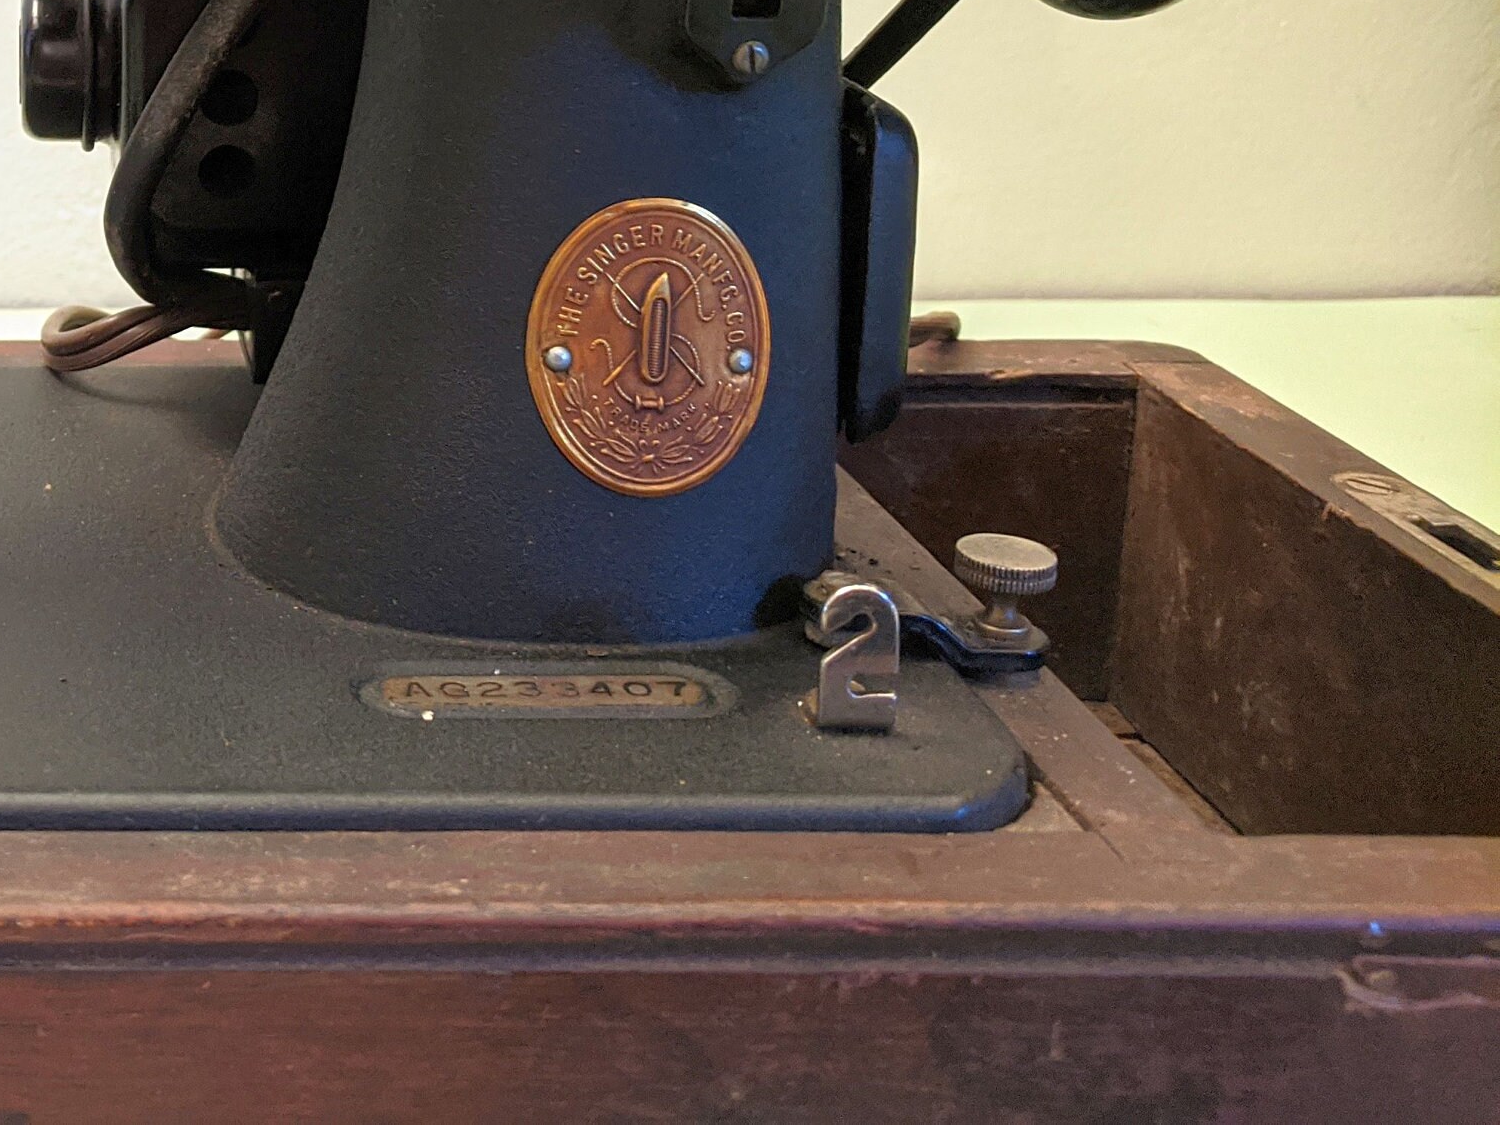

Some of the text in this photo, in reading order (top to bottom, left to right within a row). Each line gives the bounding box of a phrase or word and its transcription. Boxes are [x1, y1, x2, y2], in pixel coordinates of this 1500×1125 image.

[556, 283, 588, 336] THE
[577, 224, 664, 285] SINGER
[603, 396, 697, 433] TRADE MARK
